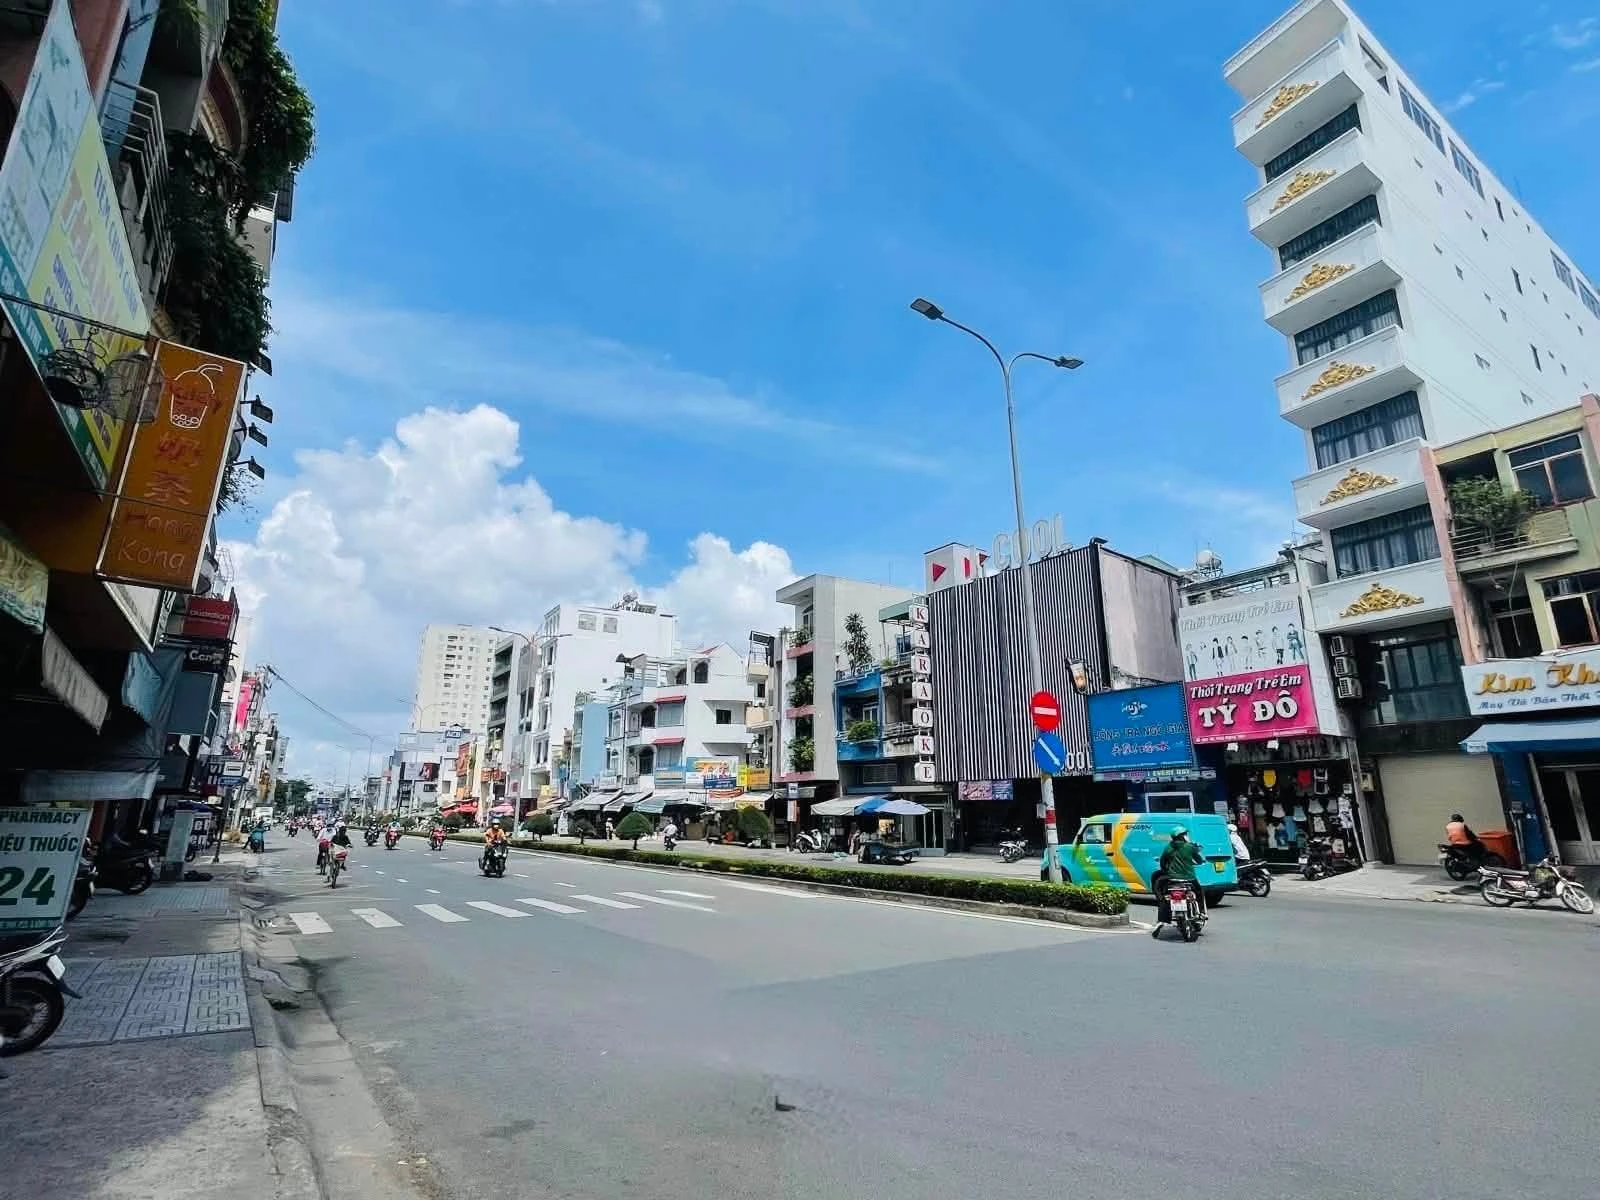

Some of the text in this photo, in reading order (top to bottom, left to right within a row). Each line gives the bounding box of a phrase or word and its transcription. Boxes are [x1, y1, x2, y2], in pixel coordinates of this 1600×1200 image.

[117, 536, 185, 570] Kong
[992, 513, 1074, 570] COOL
[914, 606, 934, 780] KARAOKE
[1214, 681, 1254, 695] Trang
[1279, 673, 1302, 687] Em
[1473, 672, 1536, 695] Kim
[1252, 689, 1298, 721] ĐÔ
[0, 811, 81, 824] PHARMACY
[29, 831, 80, 852] THUỐC
[0, 866, 56, 906] 24
